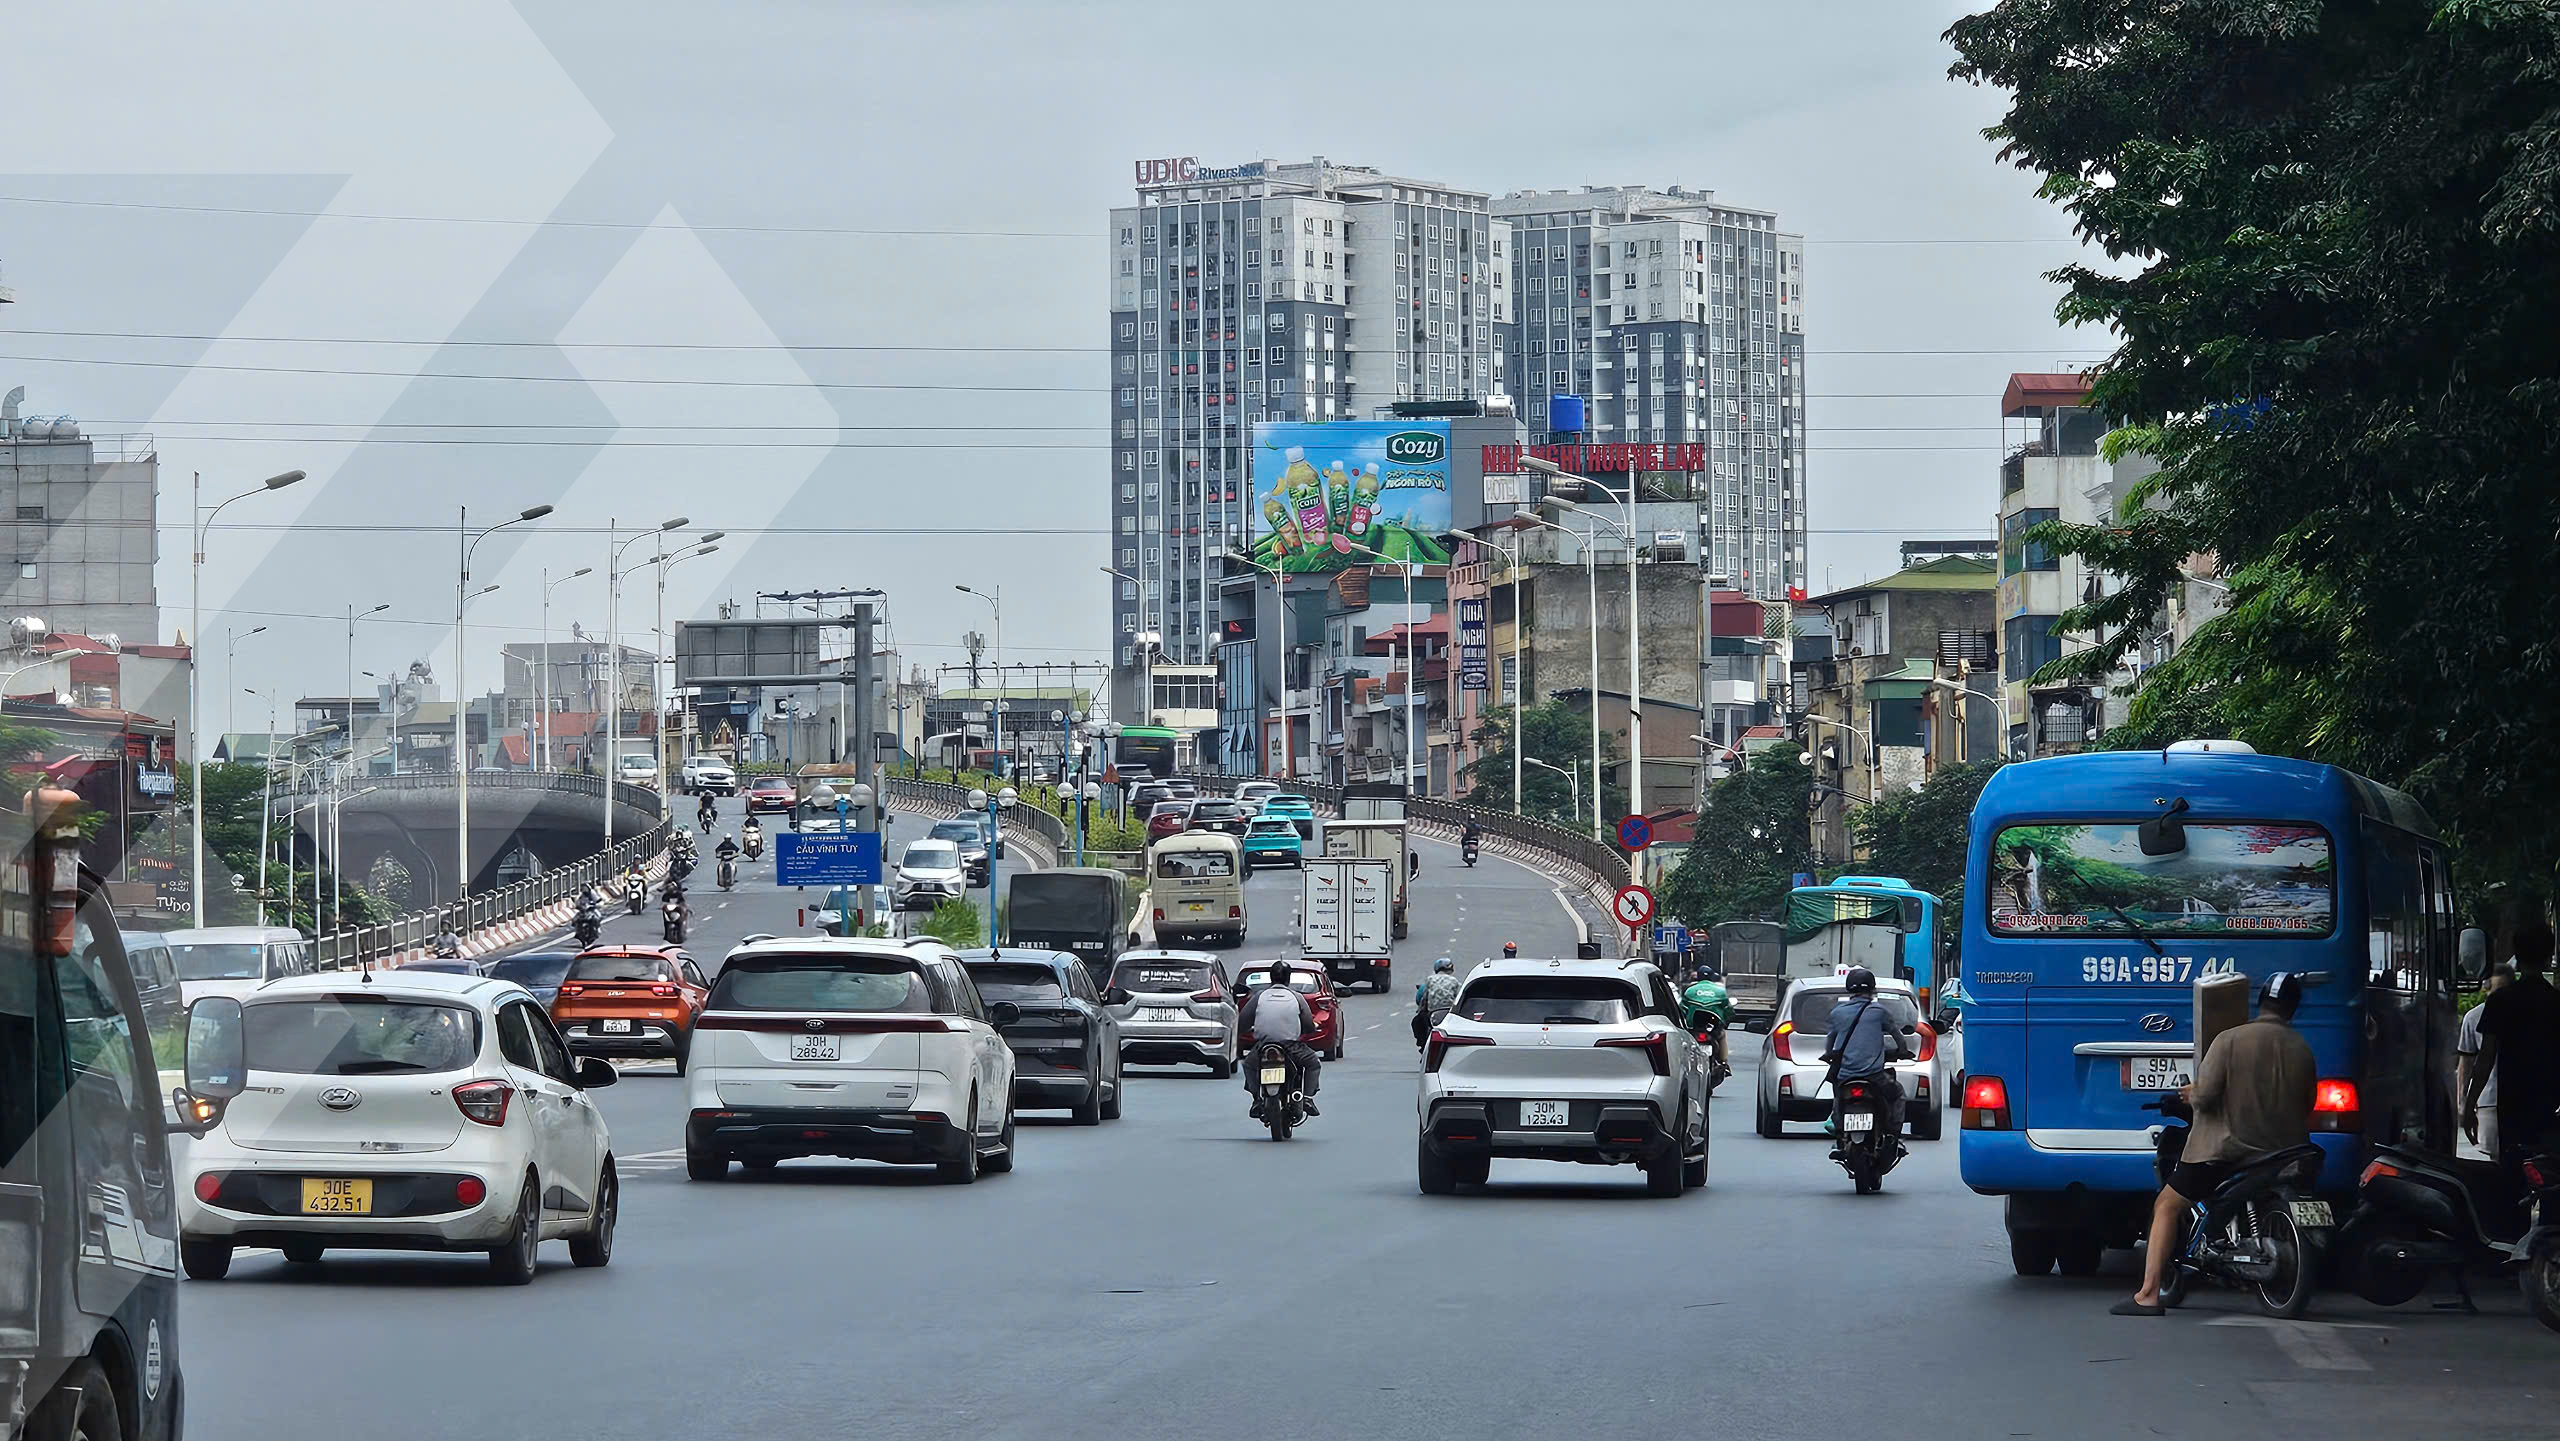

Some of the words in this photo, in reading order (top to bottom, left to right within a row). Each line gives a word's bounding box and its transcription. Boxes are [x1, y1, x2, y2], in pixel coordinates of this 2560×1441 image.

[1136, 157, 1196, 184] UDIC
[1391, 438, 1438, 458] Cozy
[1482, 440, 1525, 473] NHÀ
[1662, 443, 1706, 472] LAN
[1463, 600, 1484, 622] NHÀ
[1462, 622, 1486, 646] NGHỈ
[805, 1036, 827, 1047] 30H
[796, 1047, 835, 1059] 289.42
[2149, 1058, 2178, 1073] 99A
[2137, 1074, 2191, 1088] 997.4
[1526, 1113, 1564, 1125] 123.43
[323, 1180, 353, 1196] 30E
[309, 1197, 363, 1212] 432.51
